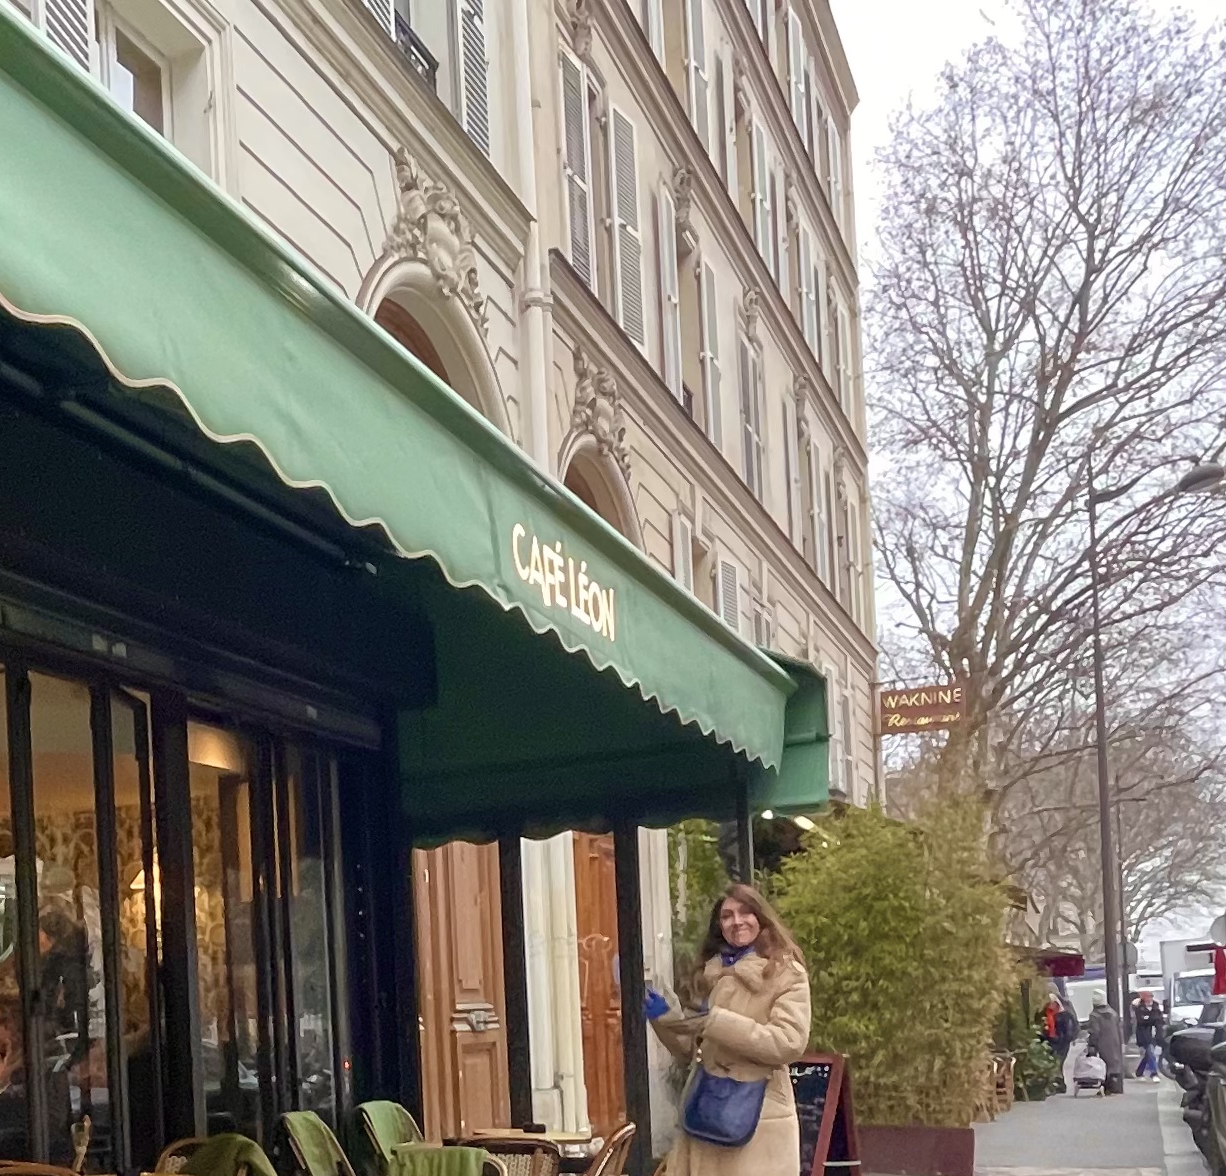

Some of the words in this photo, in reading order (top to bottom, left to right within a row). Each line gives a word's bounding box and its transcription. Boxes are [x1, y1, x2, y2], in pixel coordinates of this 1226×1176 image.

[512, 523, 567, 607] CAFÉ
[569, 557, 615, 642] LÉON
[883, 687, 962, 709] WAKNINE
